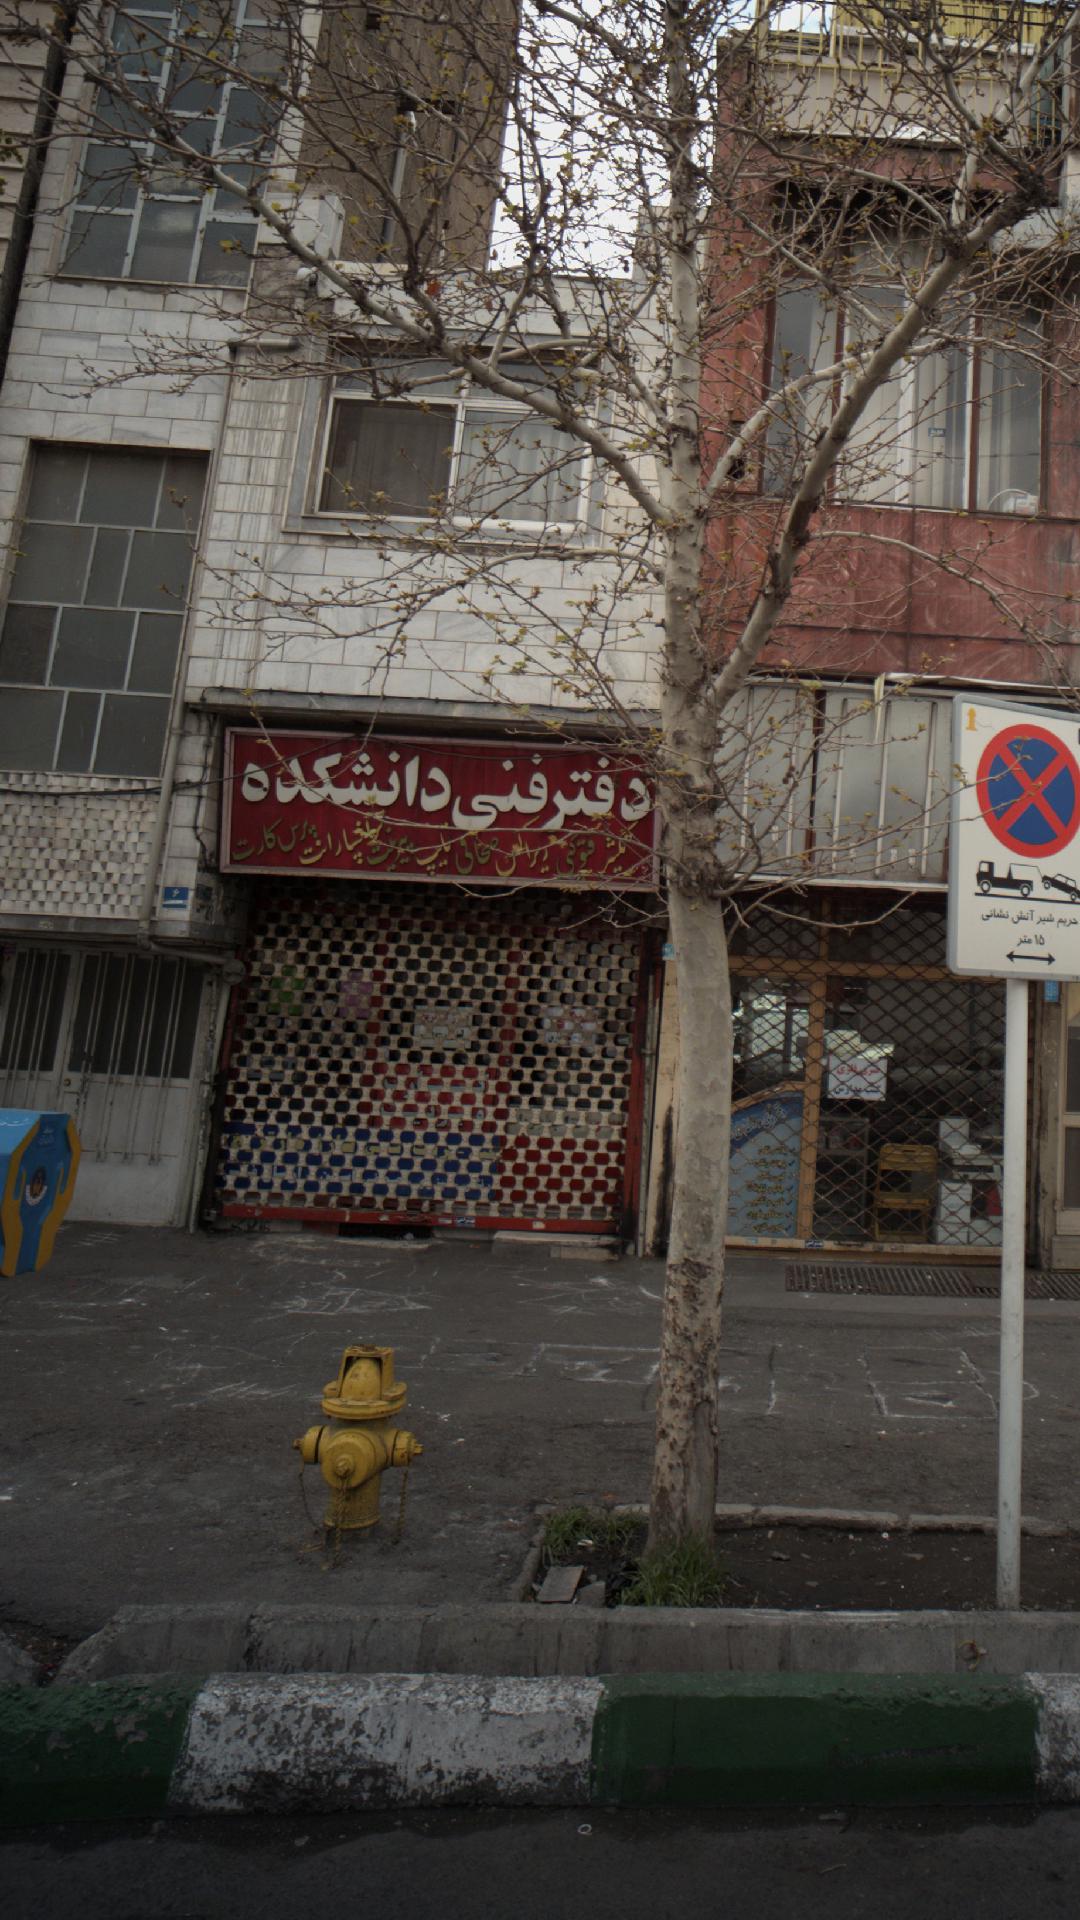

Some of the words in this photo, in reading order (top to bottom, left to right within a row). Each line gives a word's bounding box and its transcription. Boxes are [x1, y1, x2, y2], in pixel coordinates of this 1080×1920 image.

[241, 750, 451, 813] دانشکده
[452, 753, 548, 829] فنی
[541, 756, 652, 829] دفتر
[232, 817, 282, 860] کارت
[416, 832, 452, 876] تایپ
[455, 836, 499, 875] صحافی
[981, 908, 1009, 921] نشانی
[1011, 909, 1034, 924] آتش
[1036, 914, 1054, 925] شیر
[1057, 916, 1078, 928] حریم
[1016, 934, 1033, 946] متر
